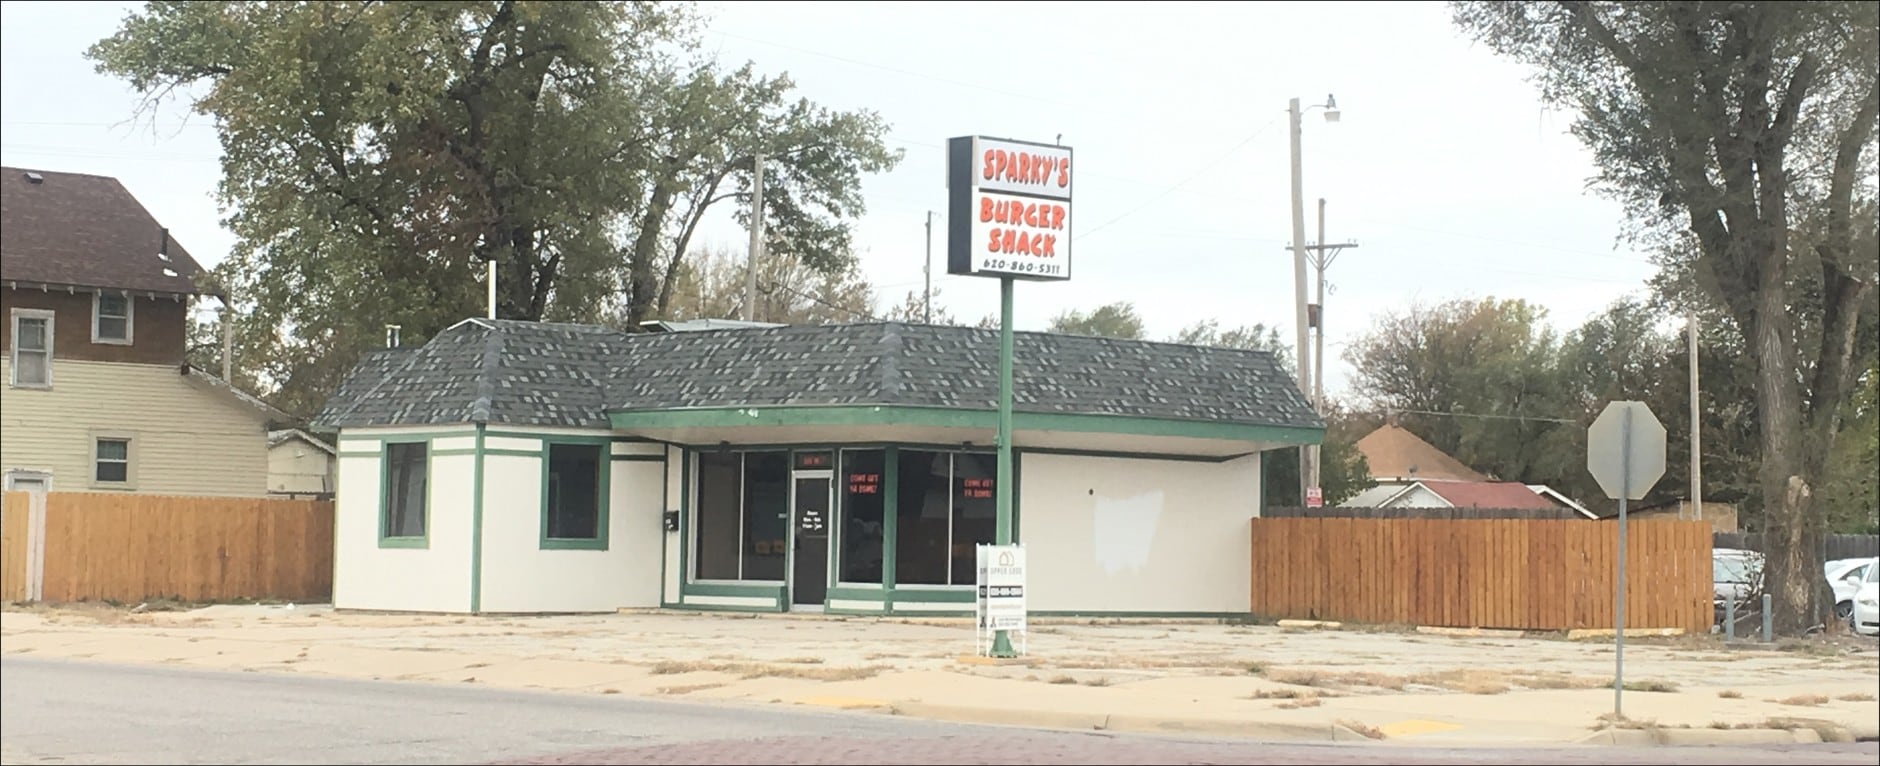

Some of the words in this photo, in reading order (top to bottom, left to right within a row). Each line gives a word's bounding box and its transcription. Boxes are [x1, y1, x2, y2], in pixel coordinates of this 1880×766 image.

[983, 149, 1069, 188] SPARKY'S
[980, 197, 1066, 231] BURGER
[988, 228, 1057, 258] SHACK
